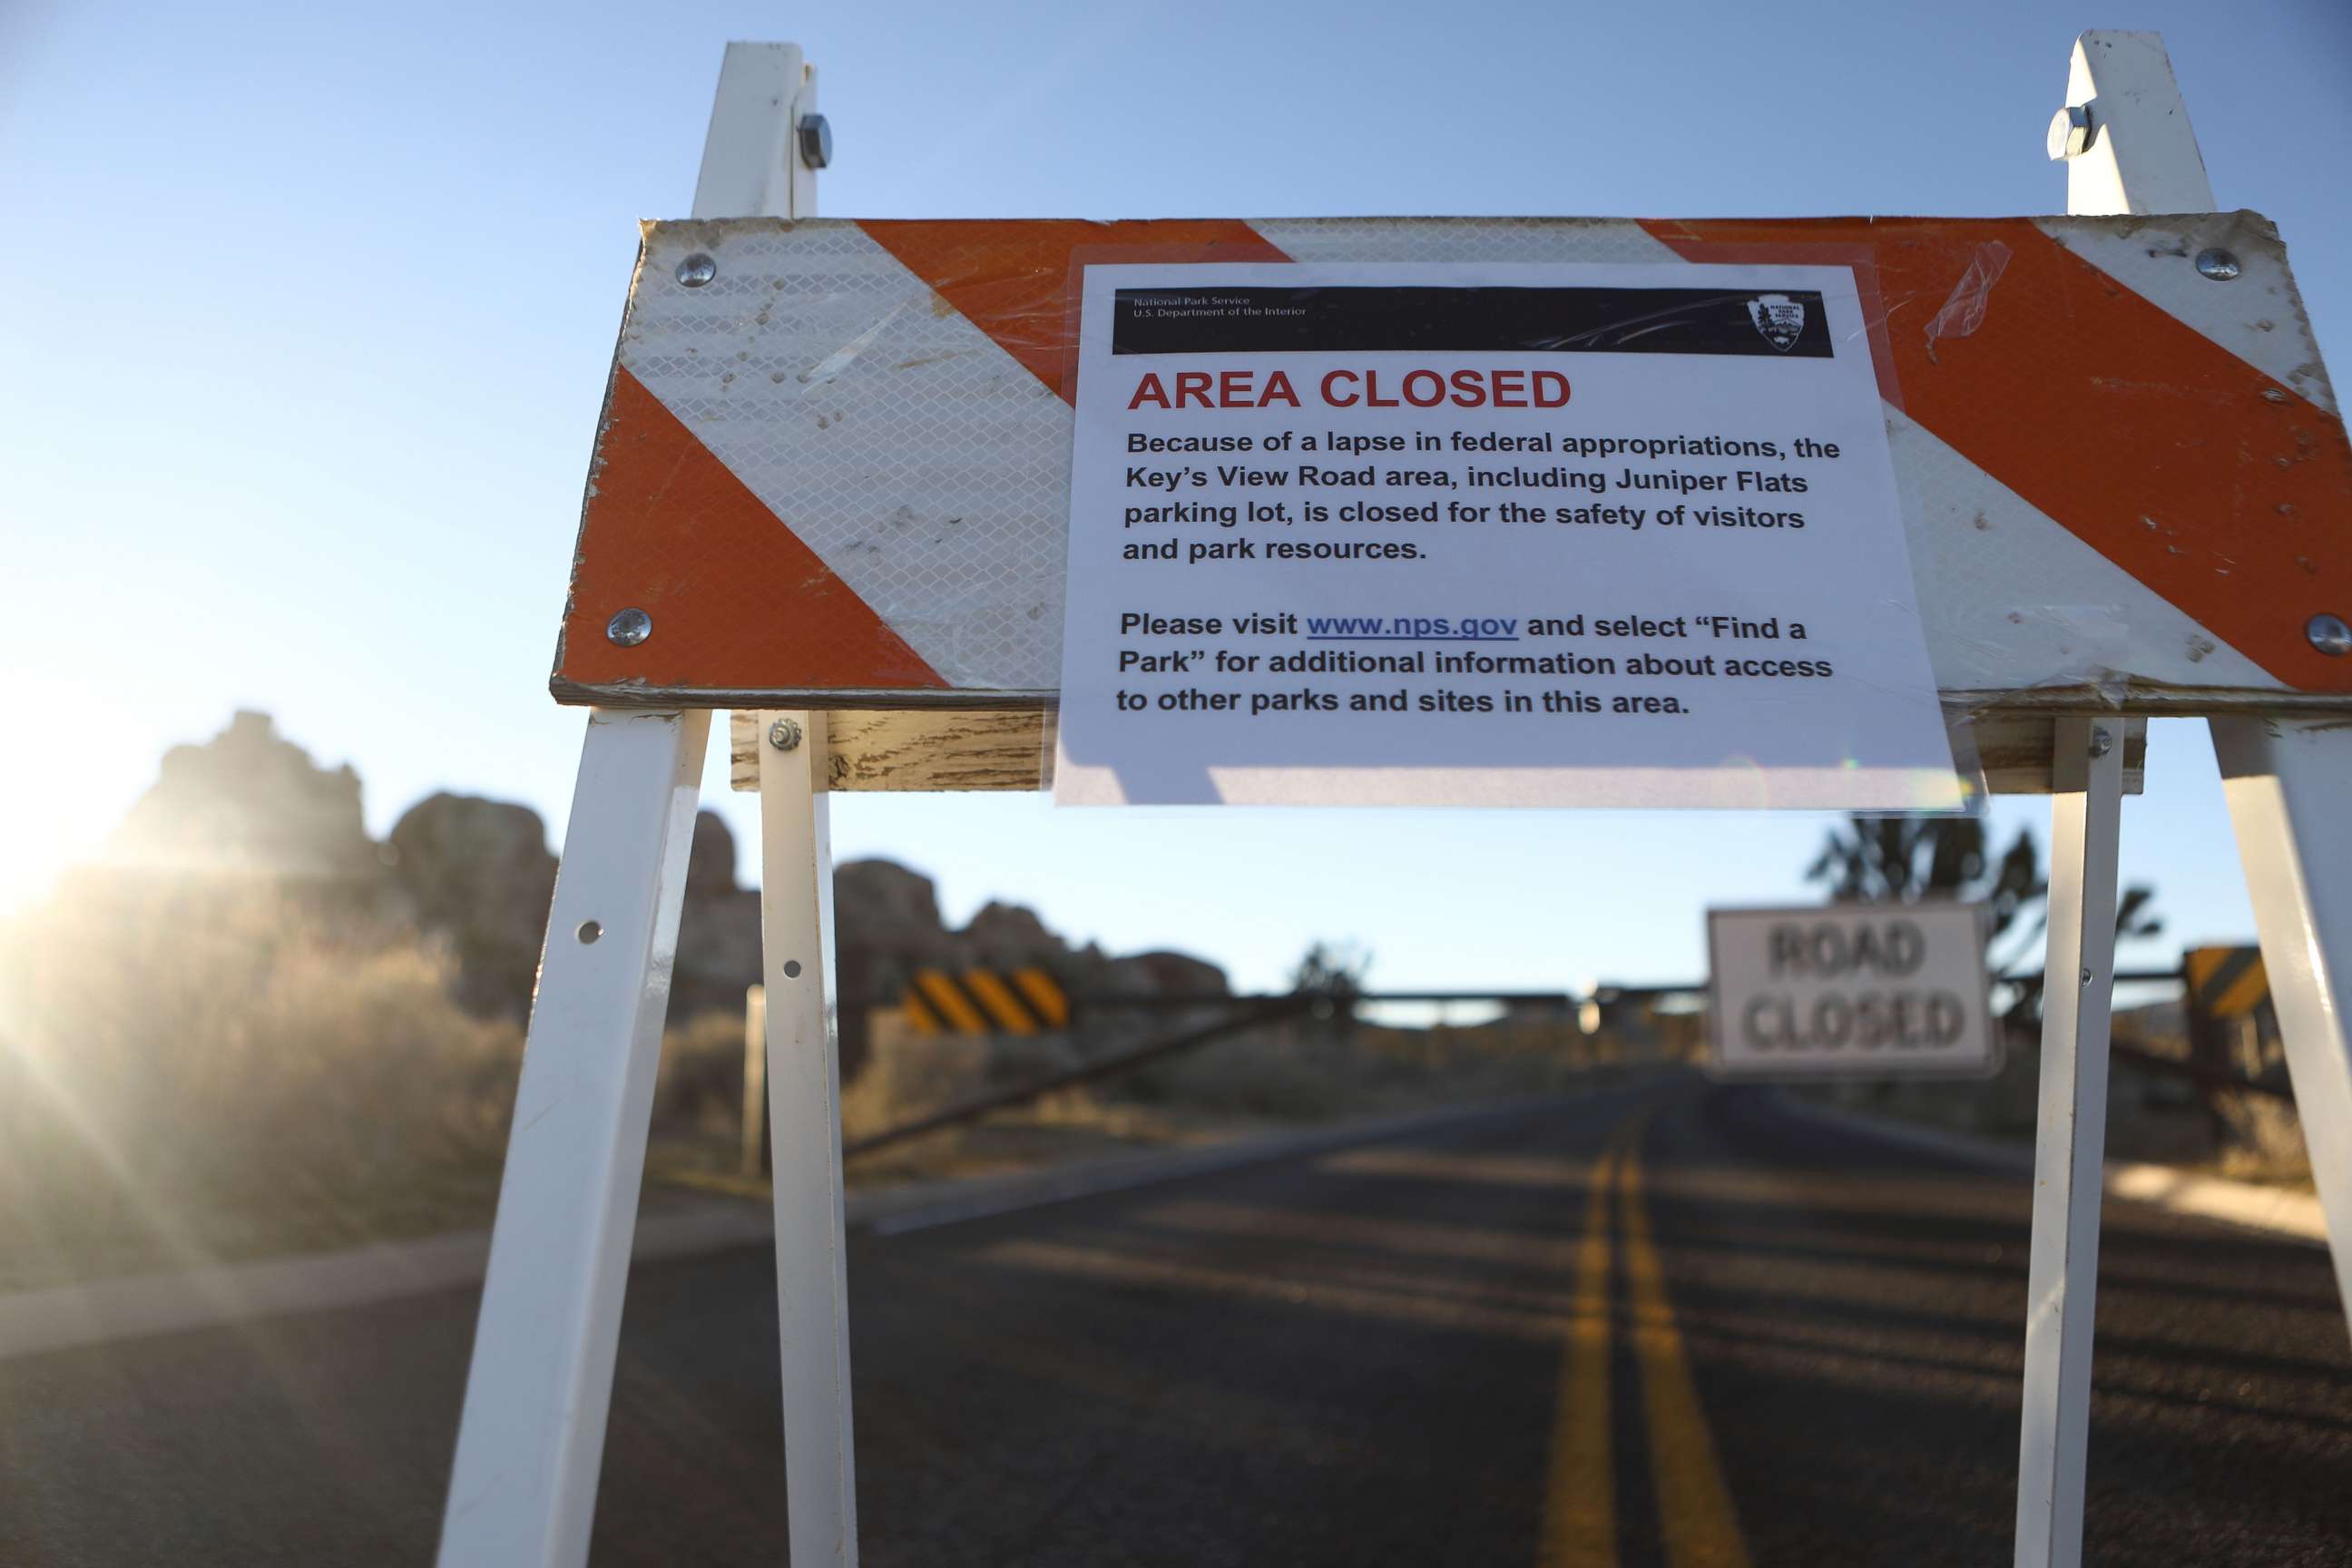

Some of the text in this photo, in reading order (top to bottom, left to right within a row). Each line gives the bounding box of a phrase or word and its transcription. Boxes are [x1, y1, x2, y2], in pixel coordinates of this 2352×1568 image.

[1133, 307, 1307, 318] U.S. Department of the Interior
[1134, 297, 1250, 307] National Park Service
[1128, 370, 1571, 409] AREA CLOSED
[1128, 431, 1839, 460] Because of a lapse in federal appropriations, the
[1217, 466, 1289, 485] View
[1299, 466, 1375, 485] Road
[1387, 471, 1456, 490] area,
[1468, 466, 1605, 494] including
[1616, 469, 1728, 495] Juniper
[1737, 471, 1808, 493] Flats
[1125, 501, 1805, 530] parking lot, is closed for the safety of visitors
[1123, 538, 1426, 564] and park resources.
[1122, 613, 1222, 634] Please
[1232, 612, 1298, 634] visit
[1307, 618, 1519, 641] www.nps.gov
[1528, 614, 1584, 636] and
[1595, 615, 1687, 637] select
[1789, 623, 1807, 639] a
[1215, 651, 1259, 672] for
[1269, 651, 1424, 672] additional
[1436, 652, 1615, 674] information
[1626, 653, 1716, 675] about
[1725, 660, 1833, 677] access
[1116, 688, 1689, 715] to other parks and sites in this area.
[1769, 919, 1926, 978] ROAD
[1743, 991, 1965, 1051] CLOSED
